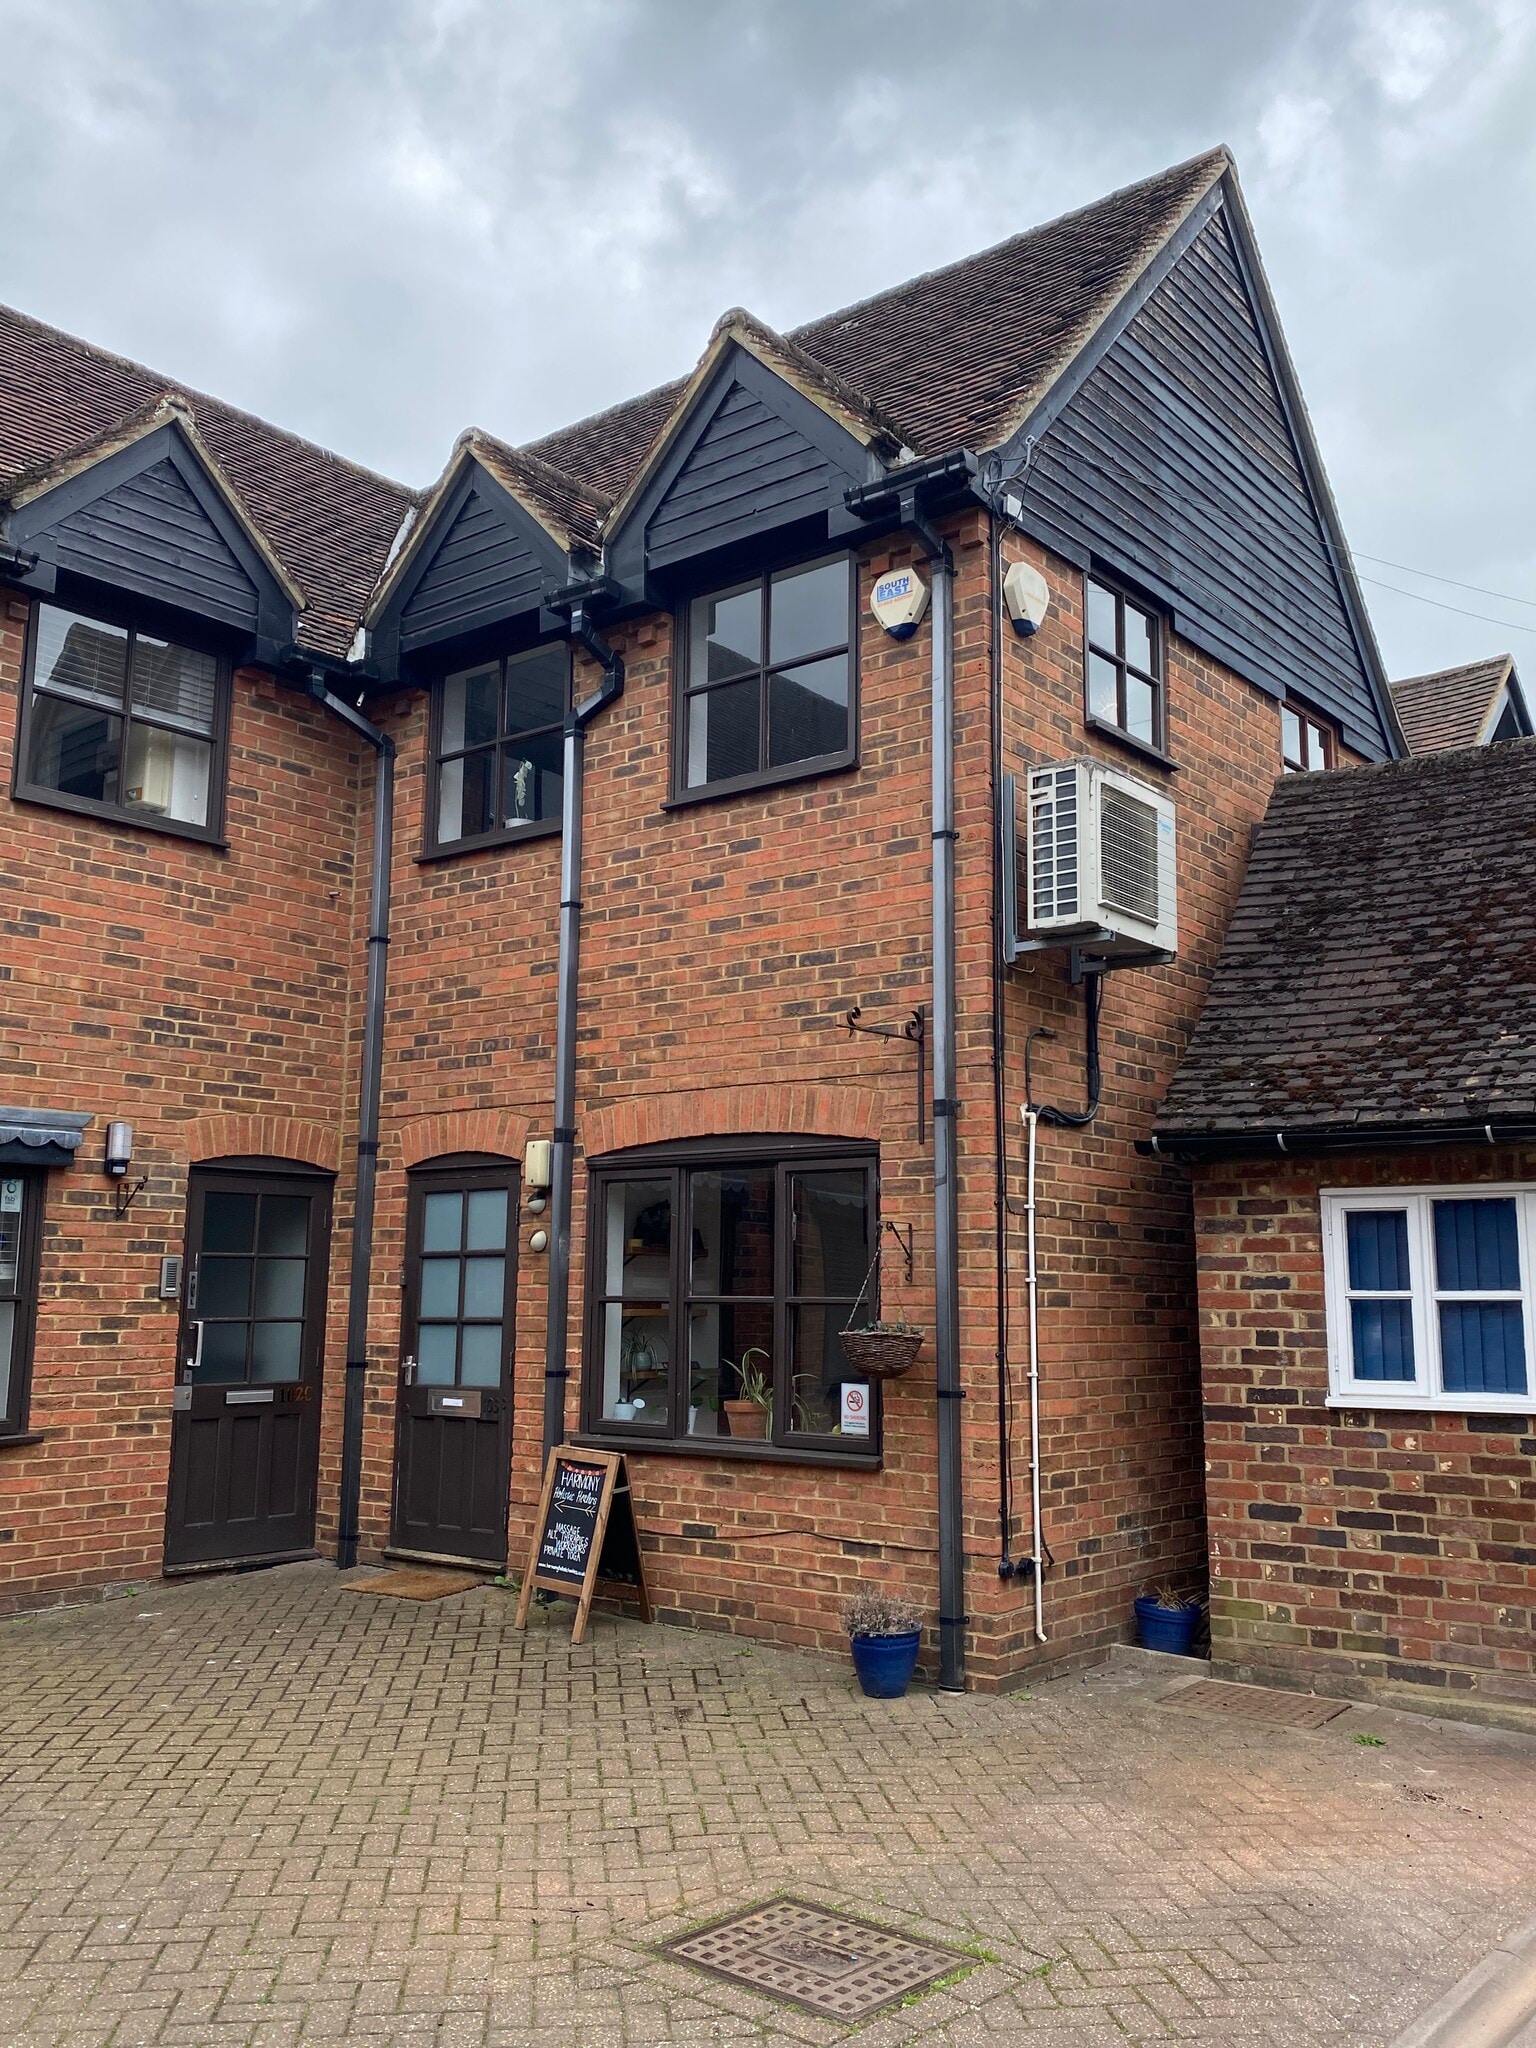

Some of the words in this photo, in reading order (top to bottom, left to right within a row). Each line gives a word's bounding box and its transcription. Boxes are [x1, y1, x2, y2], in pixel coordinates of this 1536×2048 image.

[879, 576, 909, 590] SOUTH
[879, 584, 908, 600] EAST
[561, 1471, 600, 1491] HARMONY
[555, 1522, 581, 1536] MASSAGE
[543, 1544, 564, 1559] PRIVATE
[567, 1550, 581, 1562] YOGA
